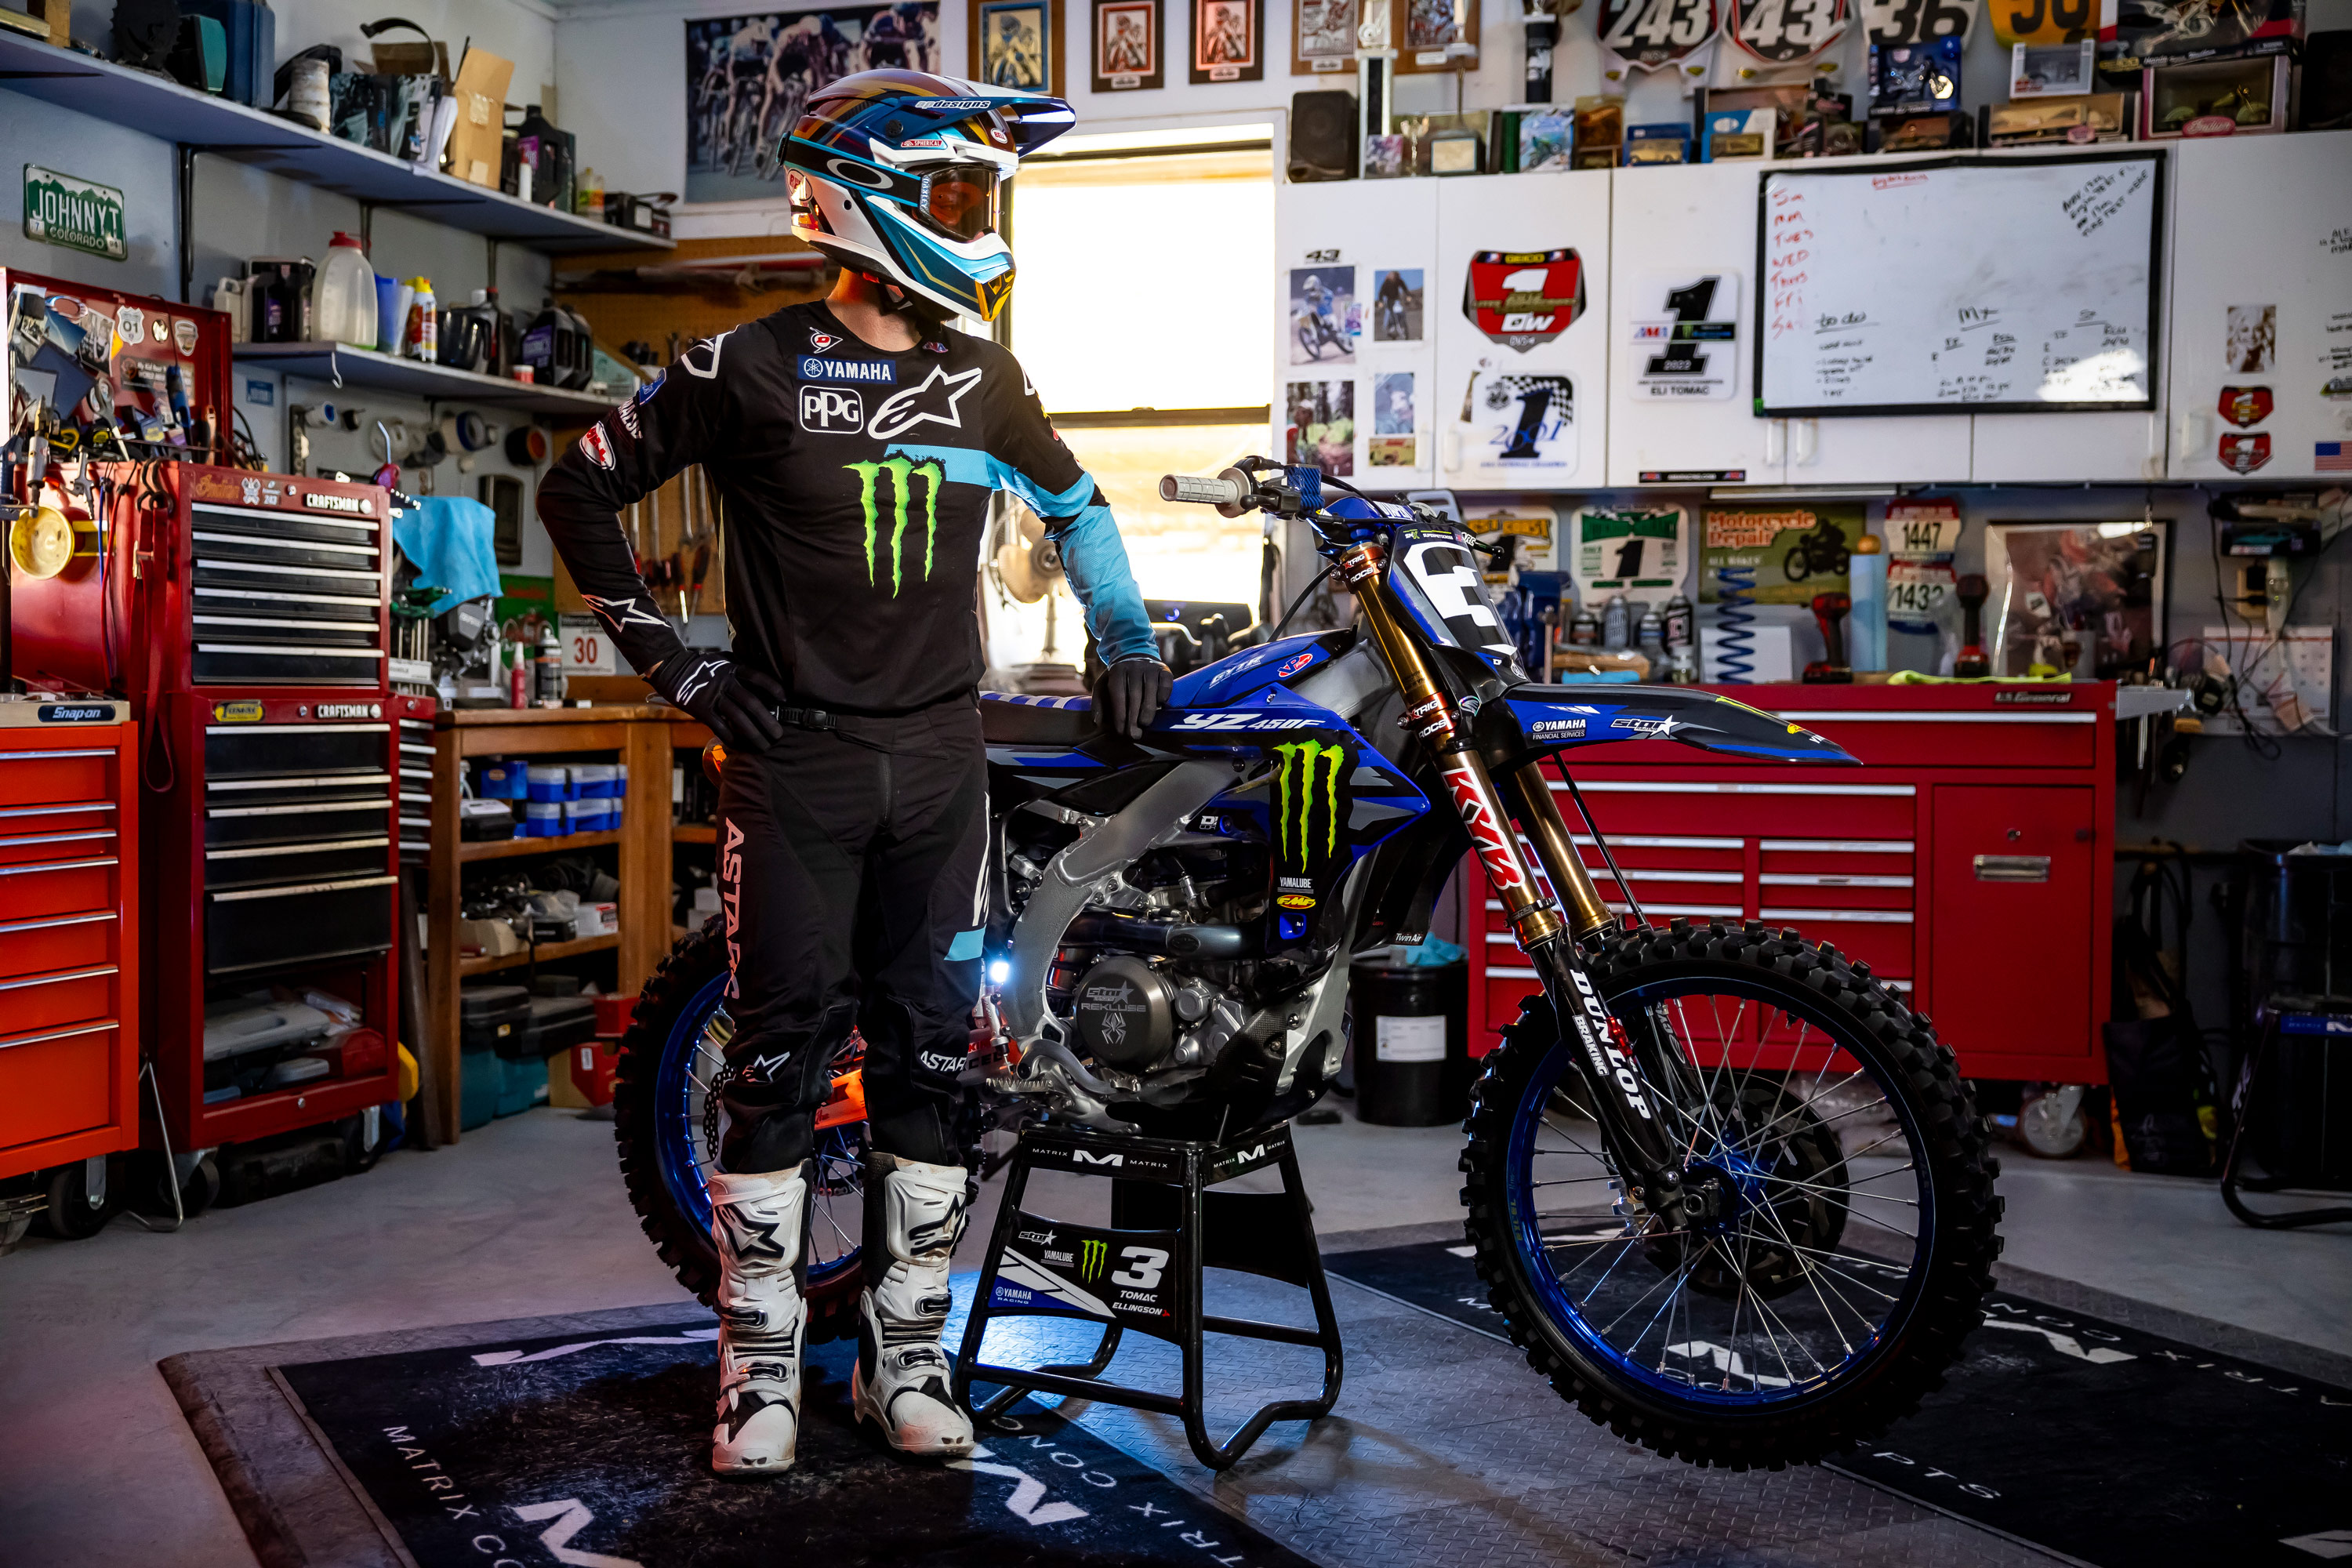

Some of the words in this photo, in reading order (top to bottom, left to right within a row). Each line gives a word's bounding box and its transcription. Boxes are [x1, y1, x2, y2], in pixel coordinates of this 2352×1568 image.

[993, 130, 1007, 141] BELL
[32, 188, 119, 240] JOHNNYT
[49, 225, 104, 249] COLORADO
[1643, 275, 1721, 377] 1
[824, 361, 891, 381] YAMAHA
[1650, 387, 1668, 395] ELI
[1671, 386, 1710, 395] TOMAC
[804, 391, 859, 427] PPG
[1498, 388, 1555, 459] 1
[307, 493, 359, 512] CRAFTSMAN
[1707, 510, 1817, 531] Motorcycle
[1707, 530, 1774, 549] Repair
[1903, 521, 1942, 550] 1447
[1343, 553, 1365, 570] XTRIG
[1615, 539, 1644, 578] 1
[1350, 567, 1374, 584] ROCS
[573, 637, 598, 663] 30
[53, 706, 102, 721] Snap-on
[318, 704, 368, 718] CRAFTSMAN
[1410, 698, 1439, 720] XTRIG
[1169, 713, 1263, 730] YZ
[1247, 719, 1327, 730] 450F
[1418, 719, 1448, 739] ROCS
[1544, 718, 1586, 731] YAMAHA
[1560, 730, 1585, 739] SERVICES
[1440, 766, 1526, 891] KYB
[1279, 877, 1312, 888] YAMALUBE
[1276, 898, 1316, 906] FMF
[1396, 932, 1412, 942] Twin
[1411, 934, 1422, 942] Air
[1080, 1002, 1147, 1012] REKLUSE
[1570, 968, 1652, 1120] DUNLOP
[1573, 1015, 1609, 1076] BRAKING
[1032, 1148, 1068, 1156] MATRIX
[1130, 1160, 1168, 1168] MATRIX
[1213, 1157, 1236, 1168] MATRIX
[1267, 1140, 1286, 1150] MATRIX
[1044, 1250, 1073, 1263] YAMALUBE
[1111, 1246, 1170, 1289] 3
[1004, 1287, 1032, 1301] YAMAHA
[1120, 1290, 1158, 1303] TOMAC
[1112, 1301, 1163, 1316] ELLINGSON
[383, 1425, 480, 1520] MATRIX
